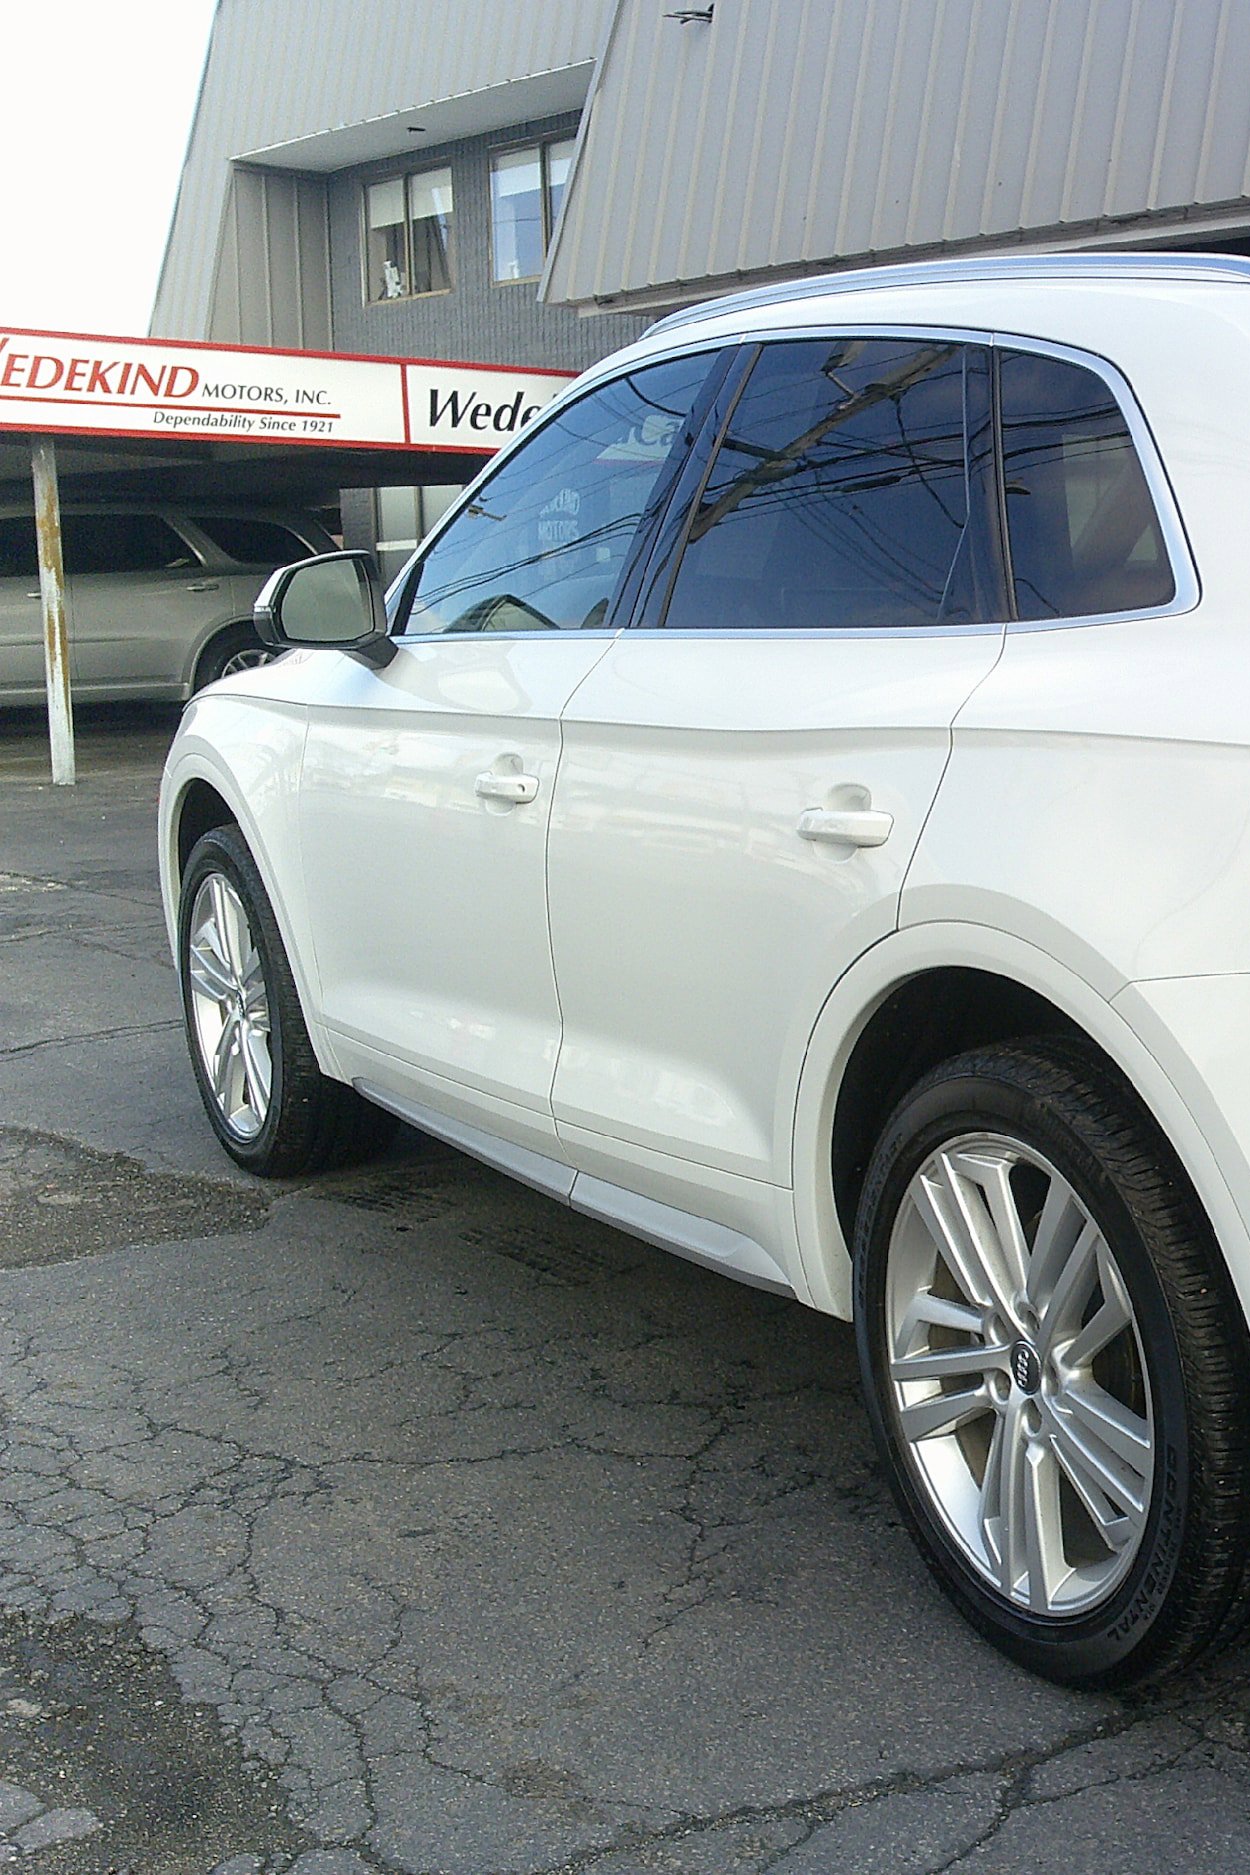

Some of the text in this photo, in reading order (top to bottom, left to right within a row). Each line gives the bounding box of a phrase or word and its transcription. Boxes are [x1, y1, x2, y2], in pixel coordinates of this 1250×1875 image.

[0, 337, 332, 405] EDEKIND MOTORS, INC.
[153, 411, 333, 433] Dependability Since 1921
